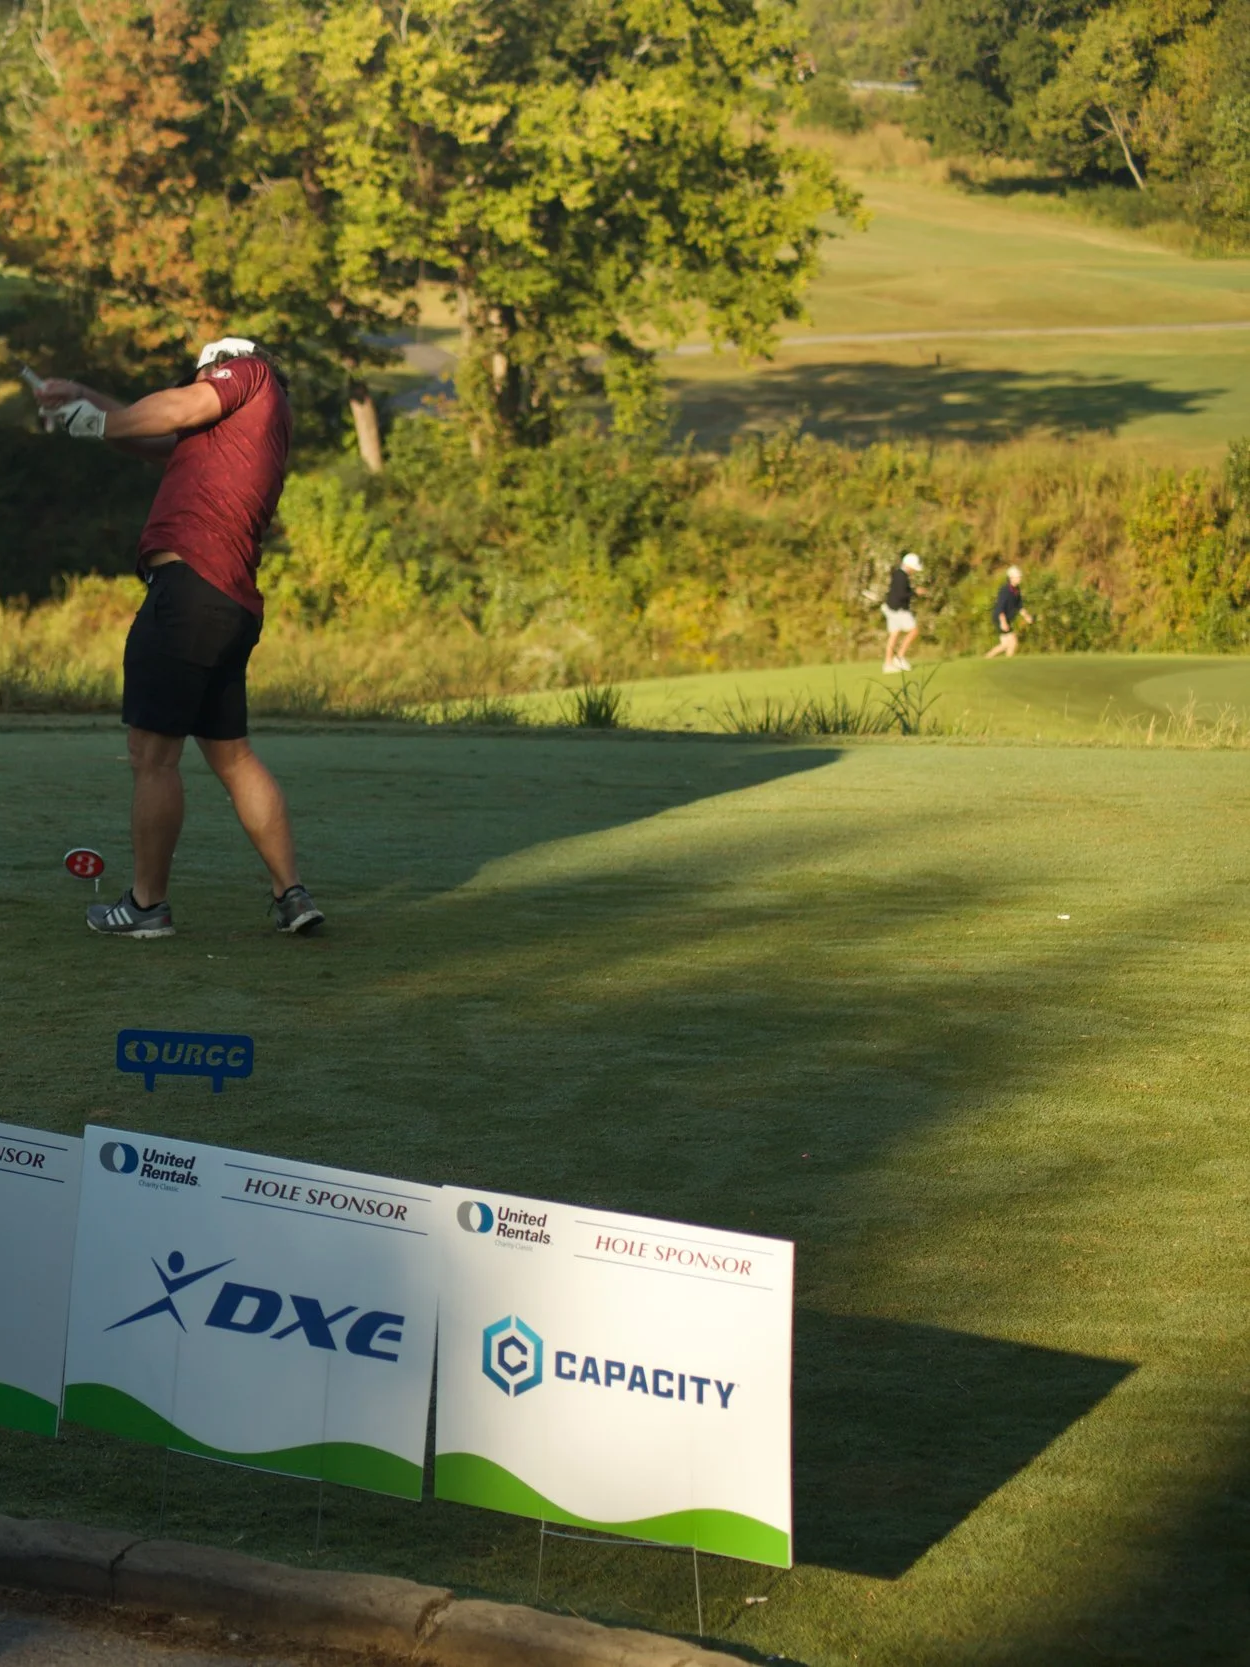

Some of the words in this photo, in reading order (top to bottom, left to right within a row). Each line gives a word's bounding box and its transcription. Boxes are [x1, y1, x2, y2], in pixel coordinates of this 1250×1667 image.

[161, 1042, 246, 1068] URCC
[143, 1148, 196, 1170] United
[138, 1179, 159, 1191] Charity
[159, 1183, 180, 1193] Classic
[244, 1178, 301, 1202] HOLE
[305, 1187, 408, 1221] SPONSOR
[497, 1206, 548, 1228] United
[595, 1235, 649, 1259] HOLE
[654, 1244, 752, 1276] SPONSOR
[204, 1281, 405, 1363] DXE
[554, 1350, 736, 1410] CAPACITY
